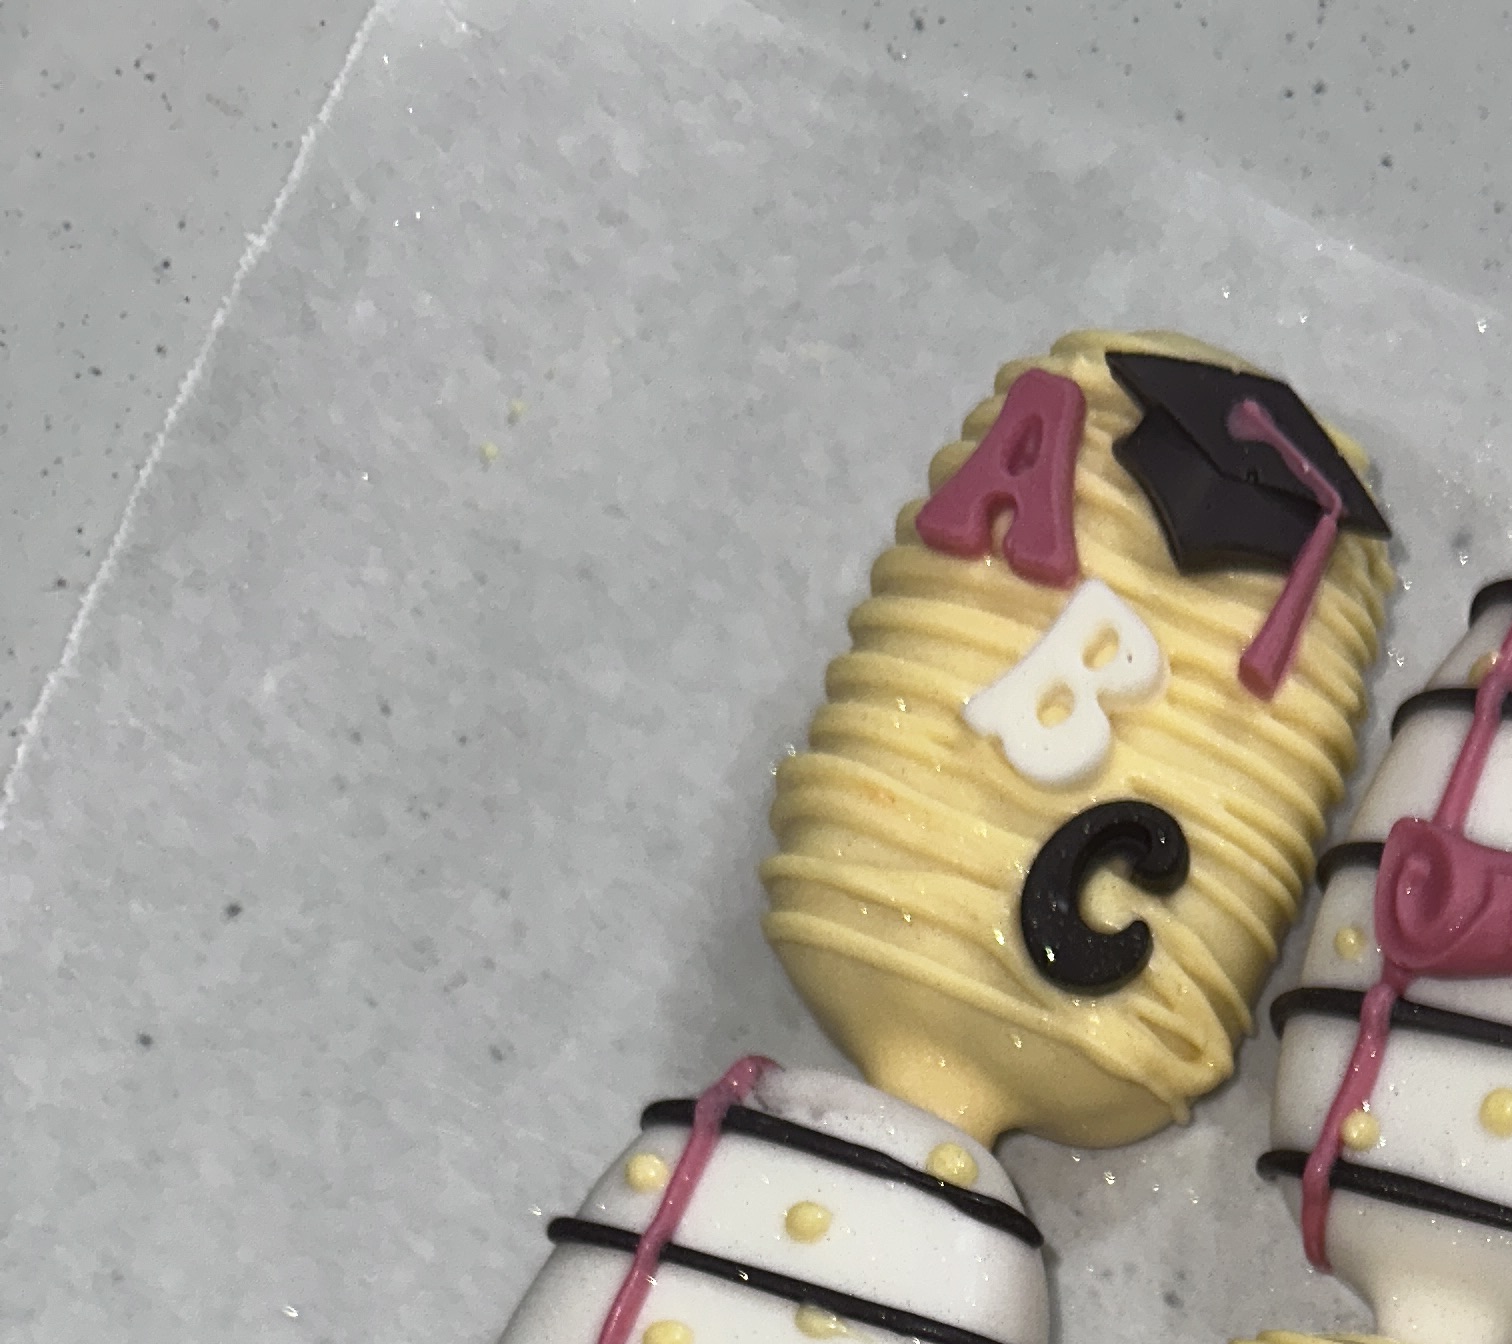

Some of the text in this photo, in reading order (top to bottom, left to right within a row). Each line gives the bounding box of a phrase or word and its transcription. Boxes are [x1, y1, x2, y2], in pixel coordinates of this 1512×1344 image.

[916, 367, 1085, 589] A
[961, 579, 1169, 788] B
[1021, 799, 1190, 995] C
